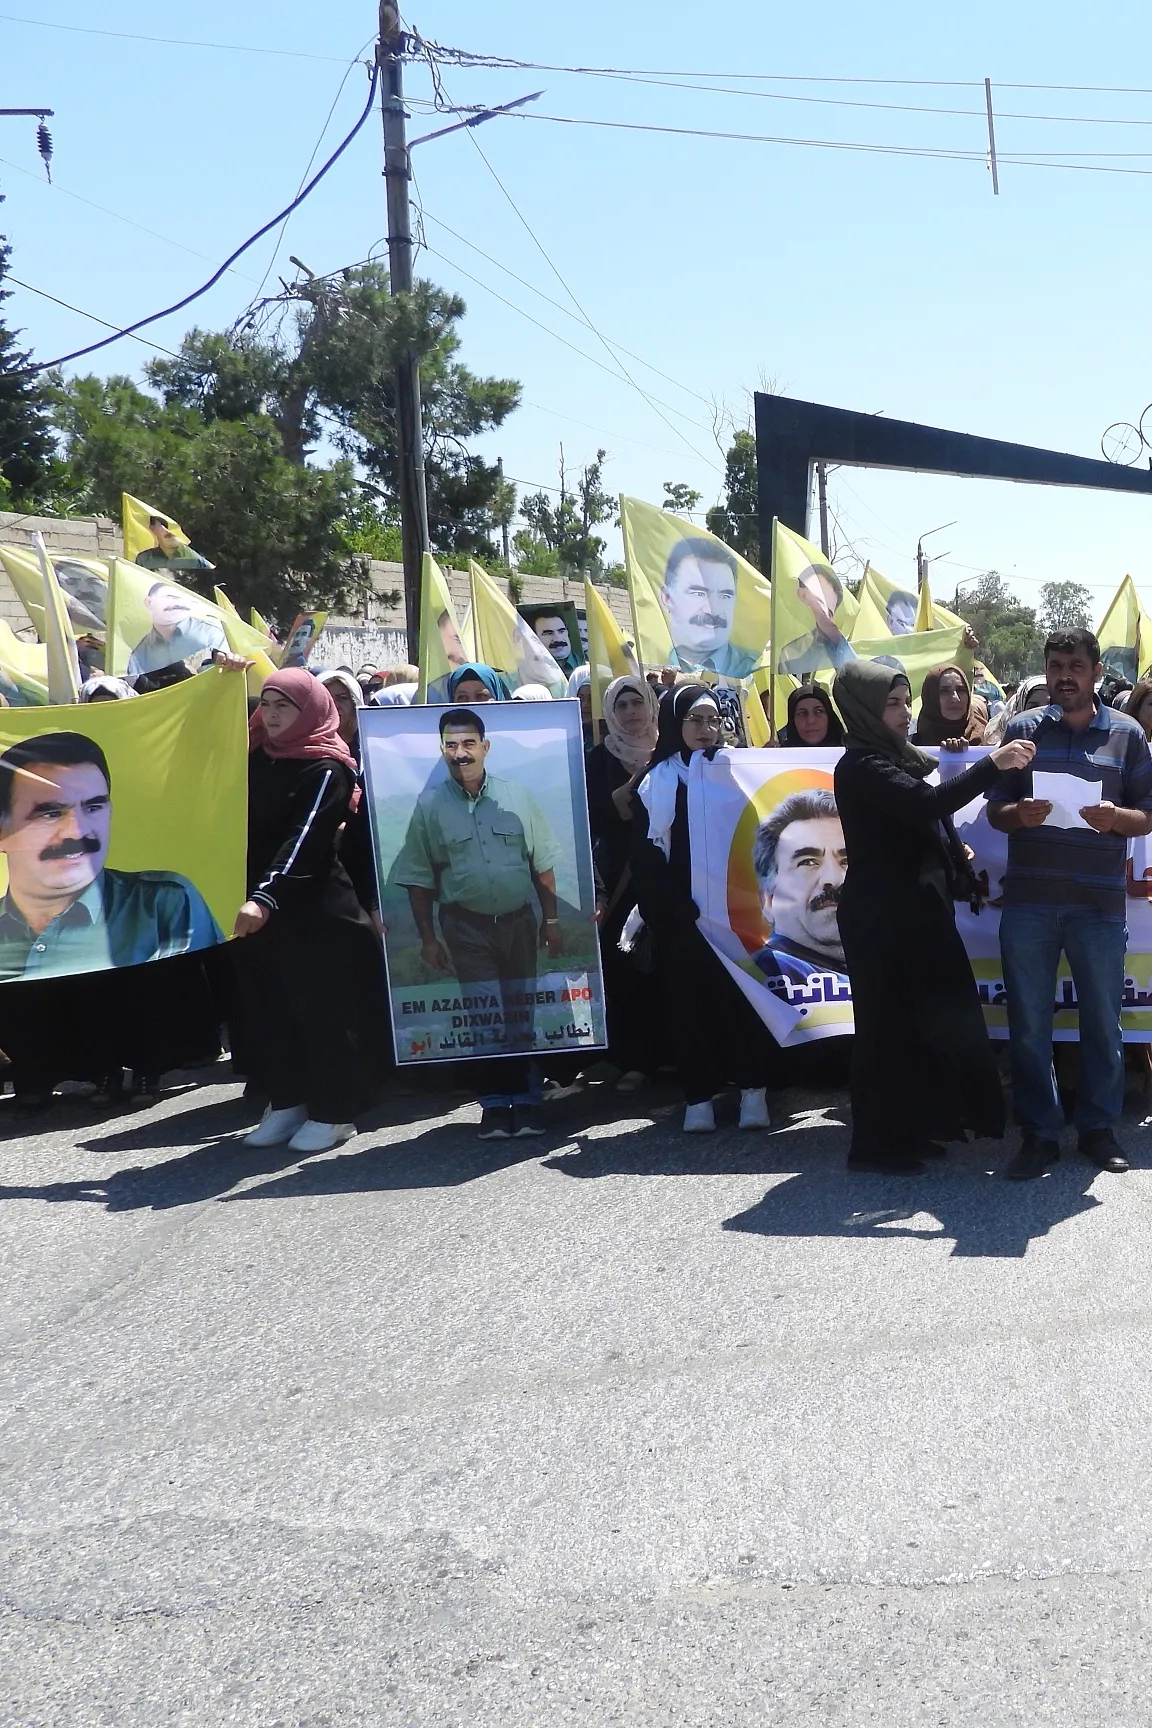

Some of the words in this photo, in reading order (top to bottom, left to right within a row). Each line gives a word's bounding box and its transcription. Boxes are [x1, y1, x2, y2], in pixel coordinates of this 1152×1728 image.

[402, 1000, 426, 1014] EM
[431, 995, 500, 1013] AZADIYA
[560, 987, 593, 1003] APO
[452, 1011, 530, 1029] DIXWAZIN
[440, 1031, 484, 1050] القائد
[545, 1022, 591, 1045] نطالب
